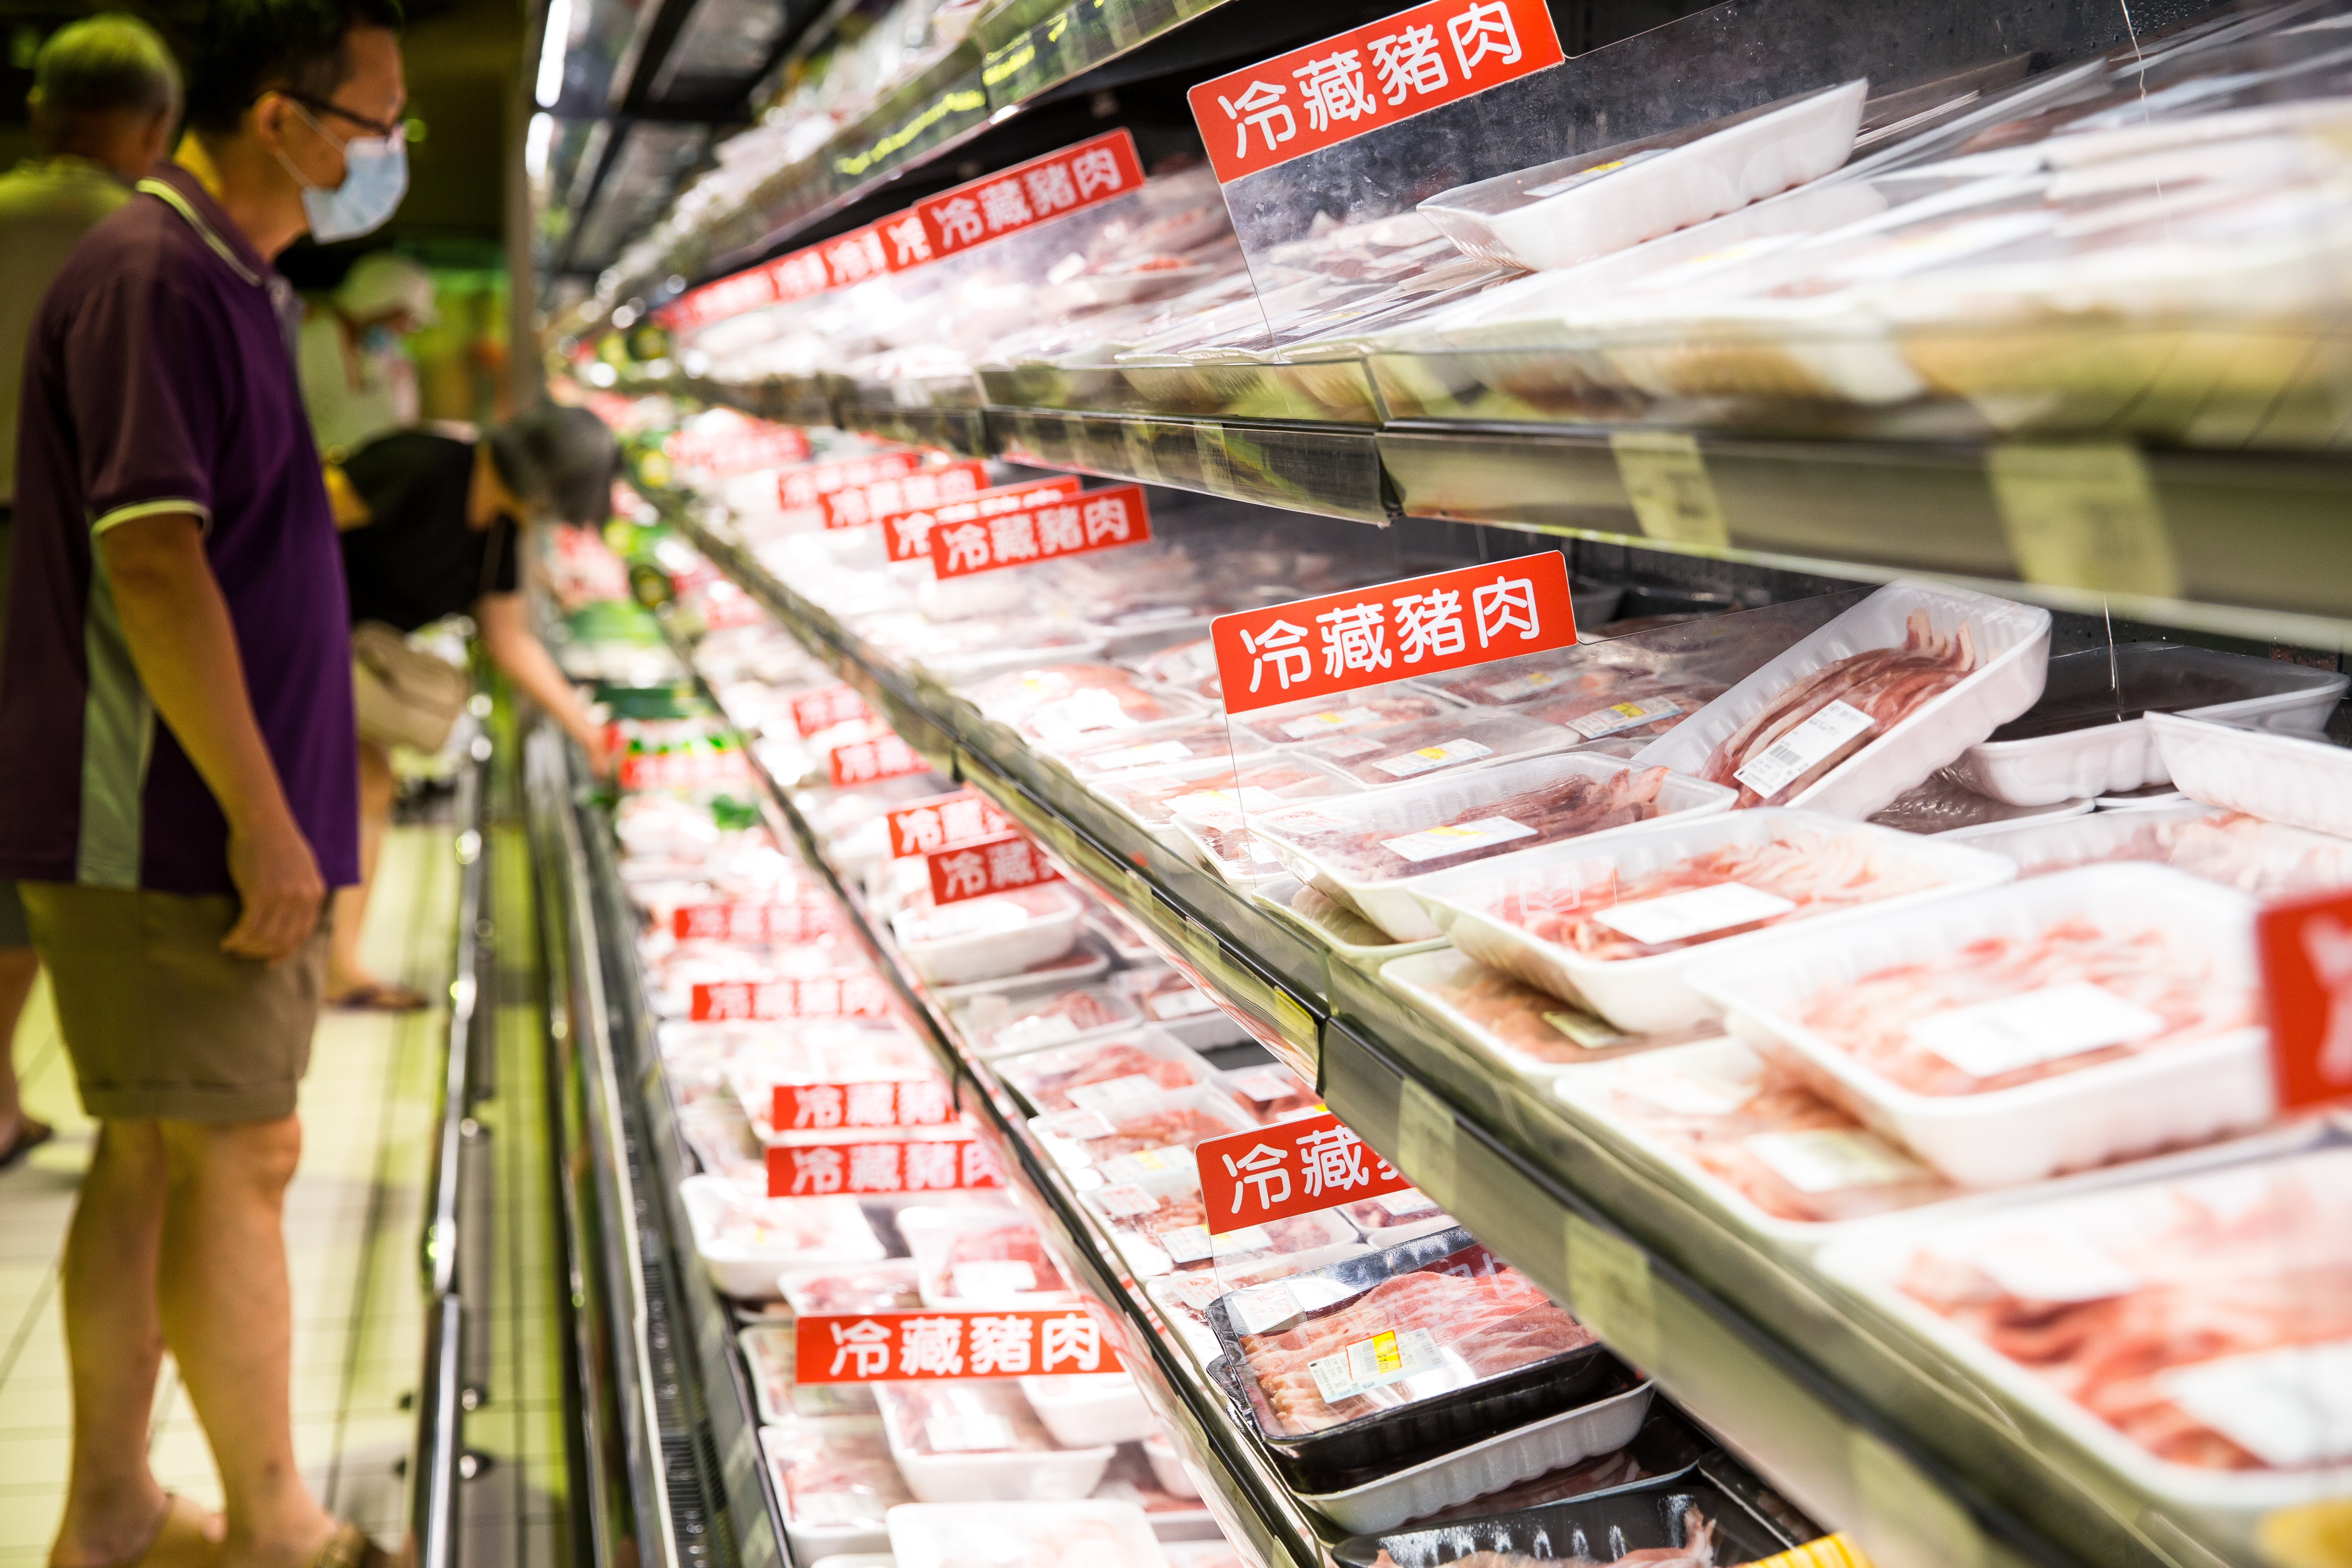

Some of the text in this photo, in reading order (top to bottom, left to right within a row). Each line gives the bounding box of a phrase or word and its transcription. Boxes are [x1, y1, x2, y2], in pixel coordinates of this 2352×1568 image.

[1218, 1, 1522, 158] 冷藏豬肉
[931, 148, 1123, 249] 冷藏豬肉
[941, 498, 1130, 572] 冷藏豬肉
[1240, 576, 1540, 693] 冷藏豬肉
[1222, 1125, 1399, 1214] 冷藏
[829, 1312, 1102, 1378] 冷藏豬肉
